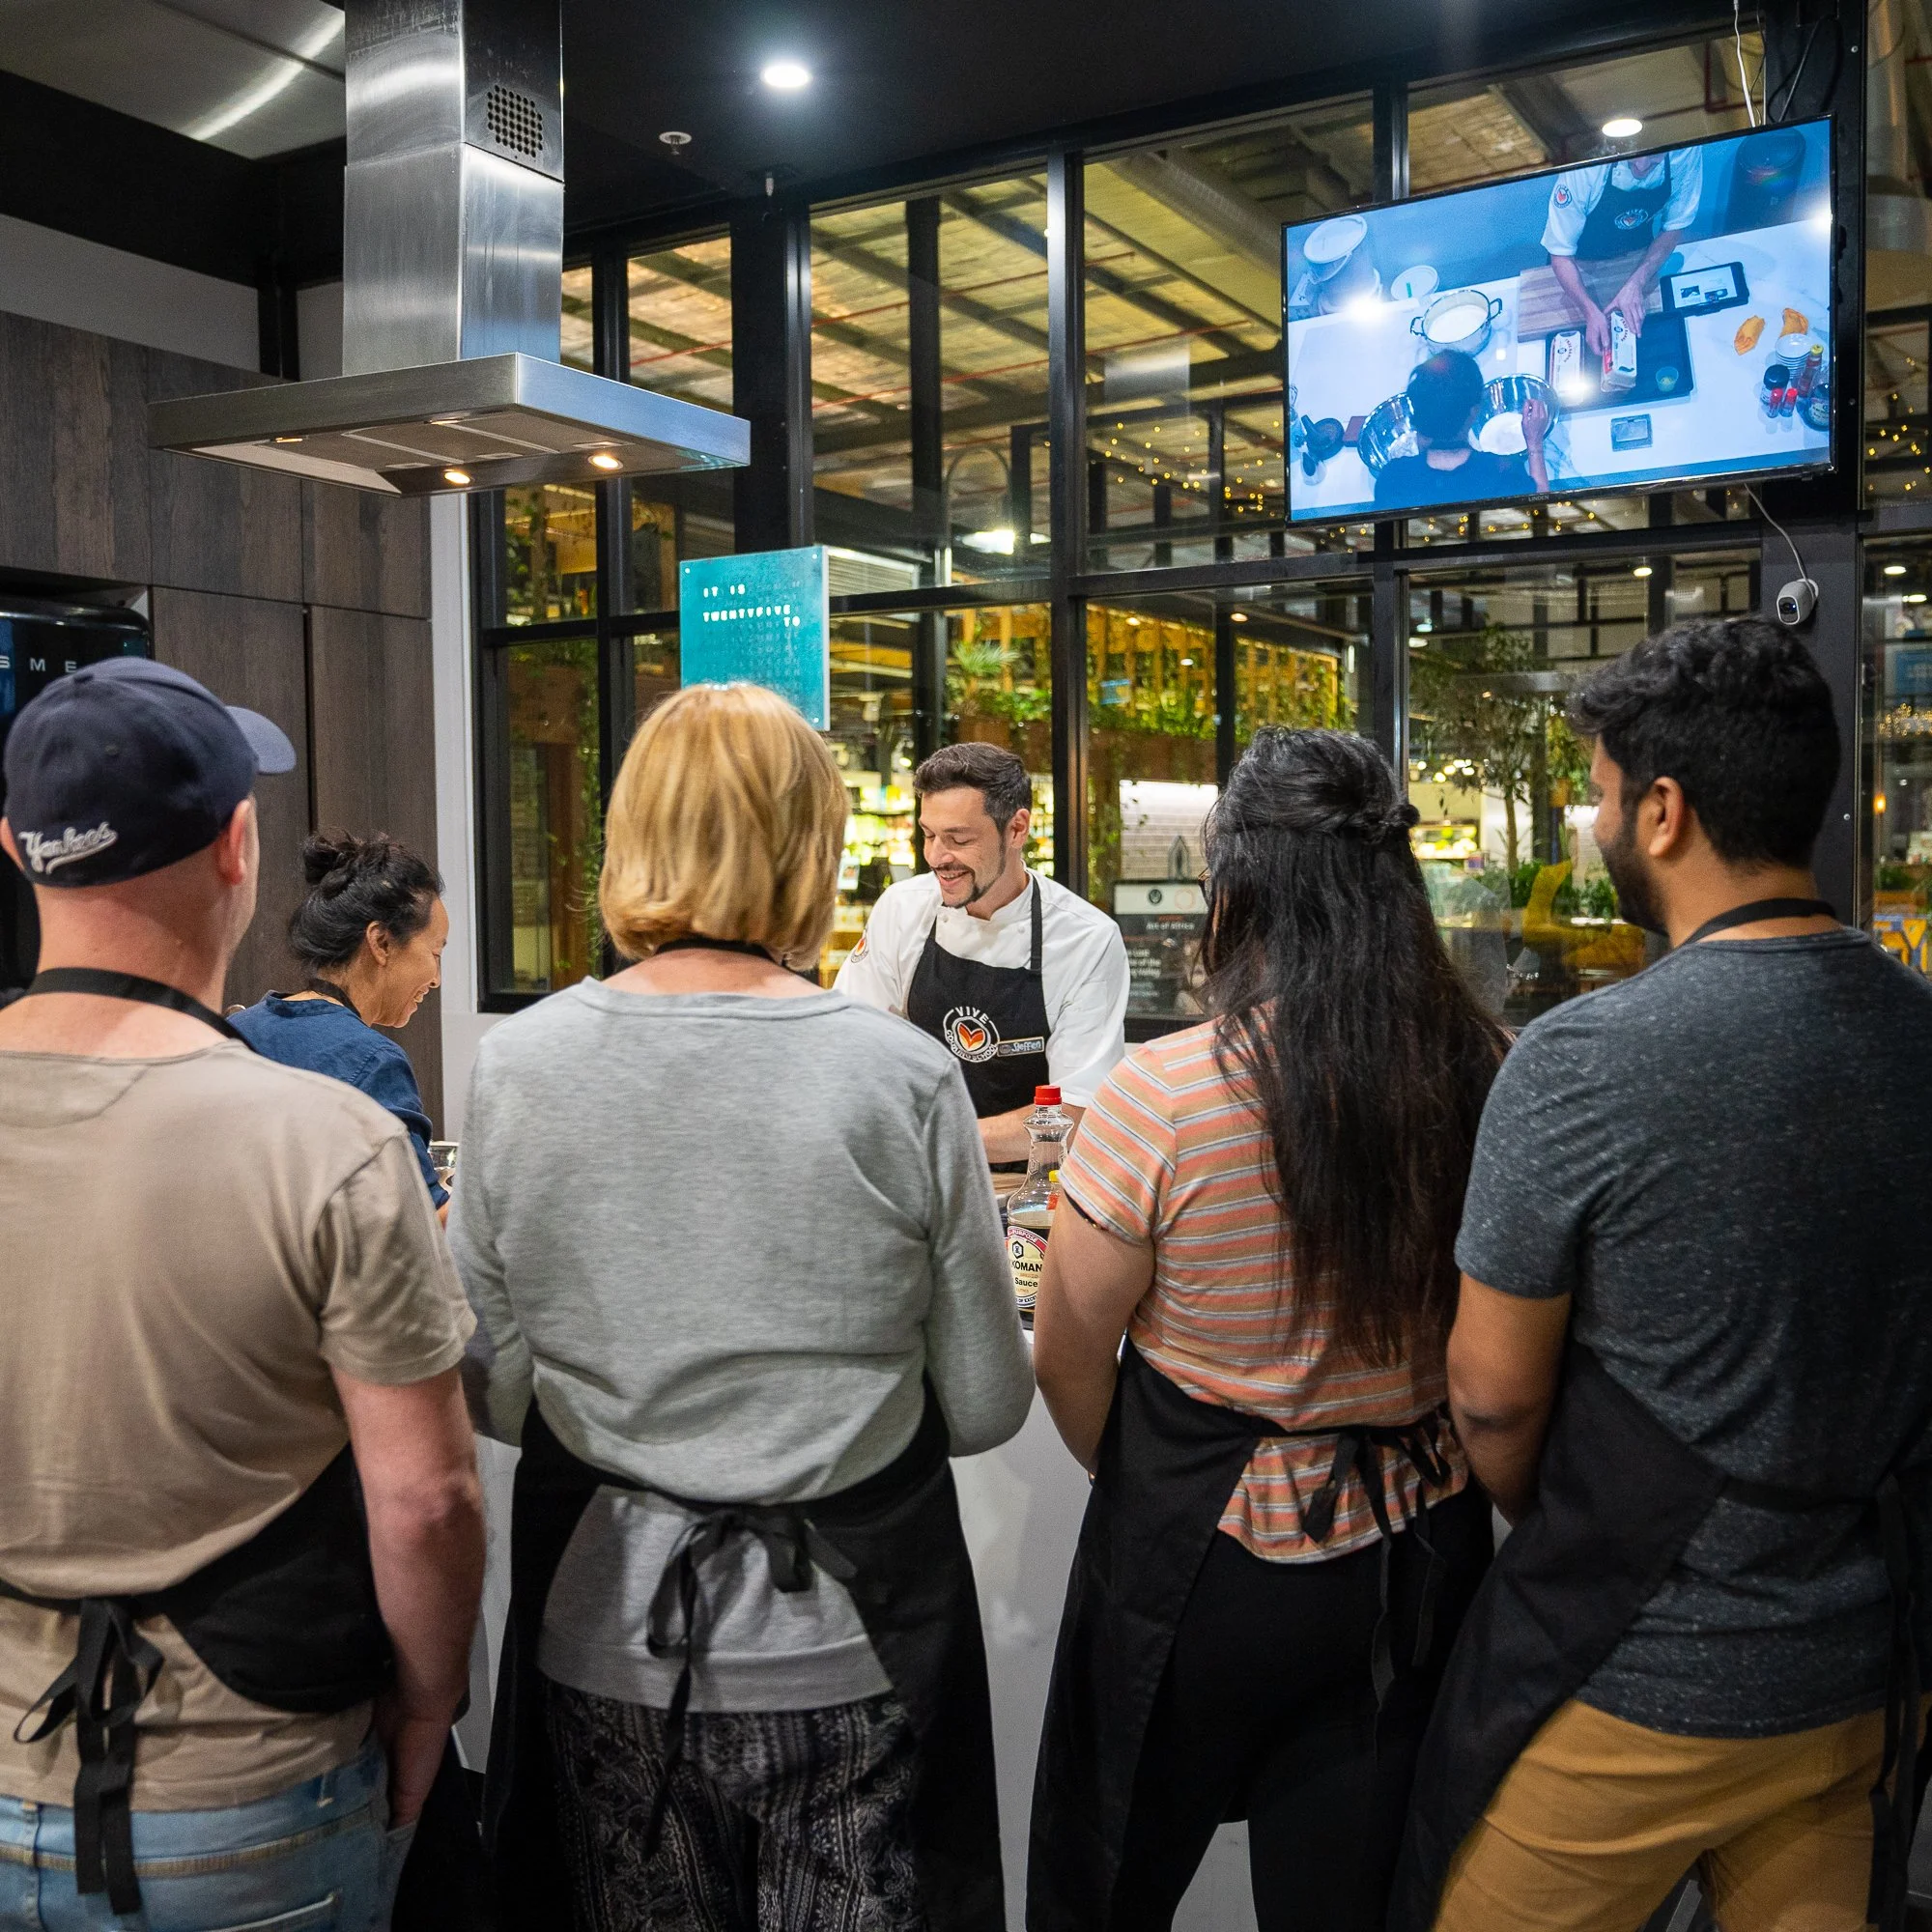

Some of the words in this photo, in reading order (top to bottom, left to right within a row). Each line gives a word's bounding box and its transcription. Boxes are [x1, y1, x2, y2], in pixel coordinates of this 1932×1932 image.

[703, 585, 719, 598] IT
[729, 583, 746, 595] IS
[783, 615, 801, 628] TO
[18, 822, 118, 873] Yankees
[955, 1006, 989, 1024] VIVE
[972, 1043, 998, 1061] SCHOOL
[1014, 1276, 1038, 1288] Sauce
